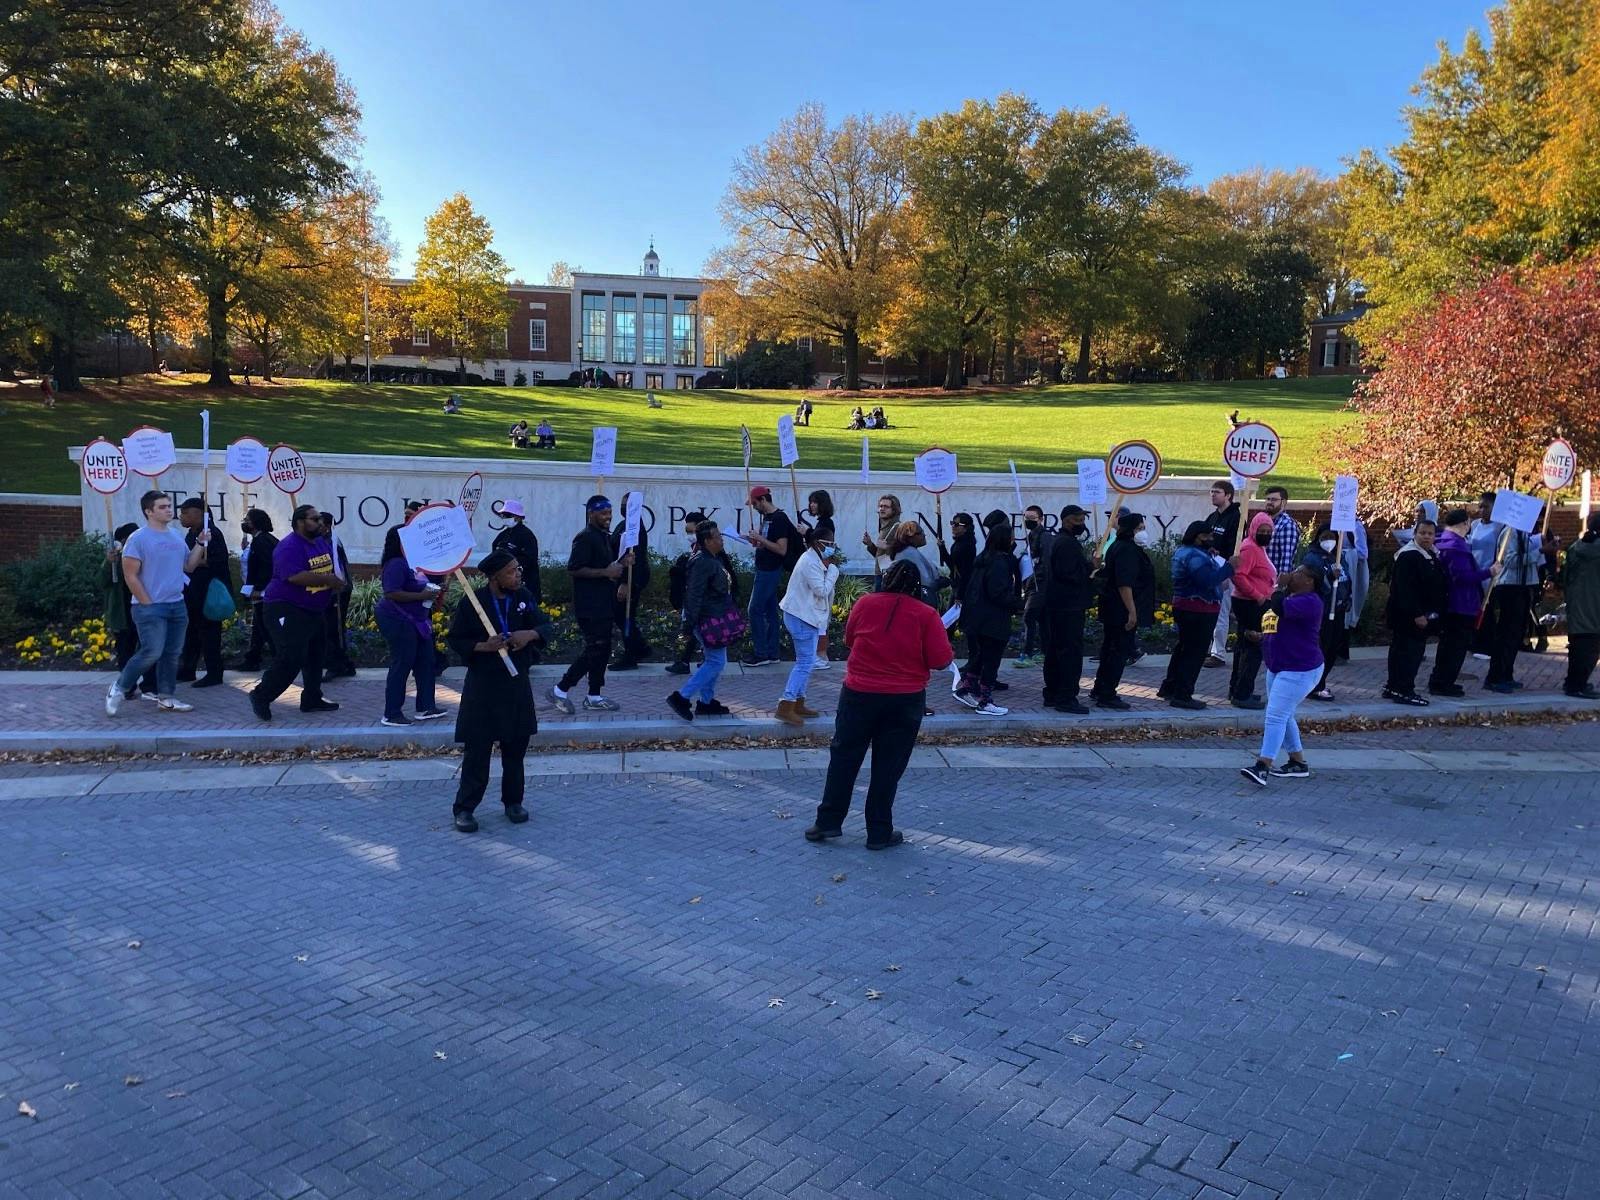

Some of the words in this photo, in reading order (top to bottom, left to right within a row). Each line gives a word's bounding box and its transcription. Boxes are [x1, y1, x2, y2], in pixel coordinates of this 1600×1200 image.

[1231, 437, 1277, 451] UNITE
[86, 455, 123, 467] UNITE
[271, 457, 301, 471] UNITE
[1118, 455, 1153, 470] UNITE
[1229, 450, 1274, 465] HERE!
[1546, 454, 1571, 467] UNITE
[88, 468, 123, 480] HERE!
[274, 468, 303, 482] HERE!
[1115, 465, 1149, 480] HERE!
[1544, 464, 1568, 479] HERE!
[332, 496, 509, 531] JOS
